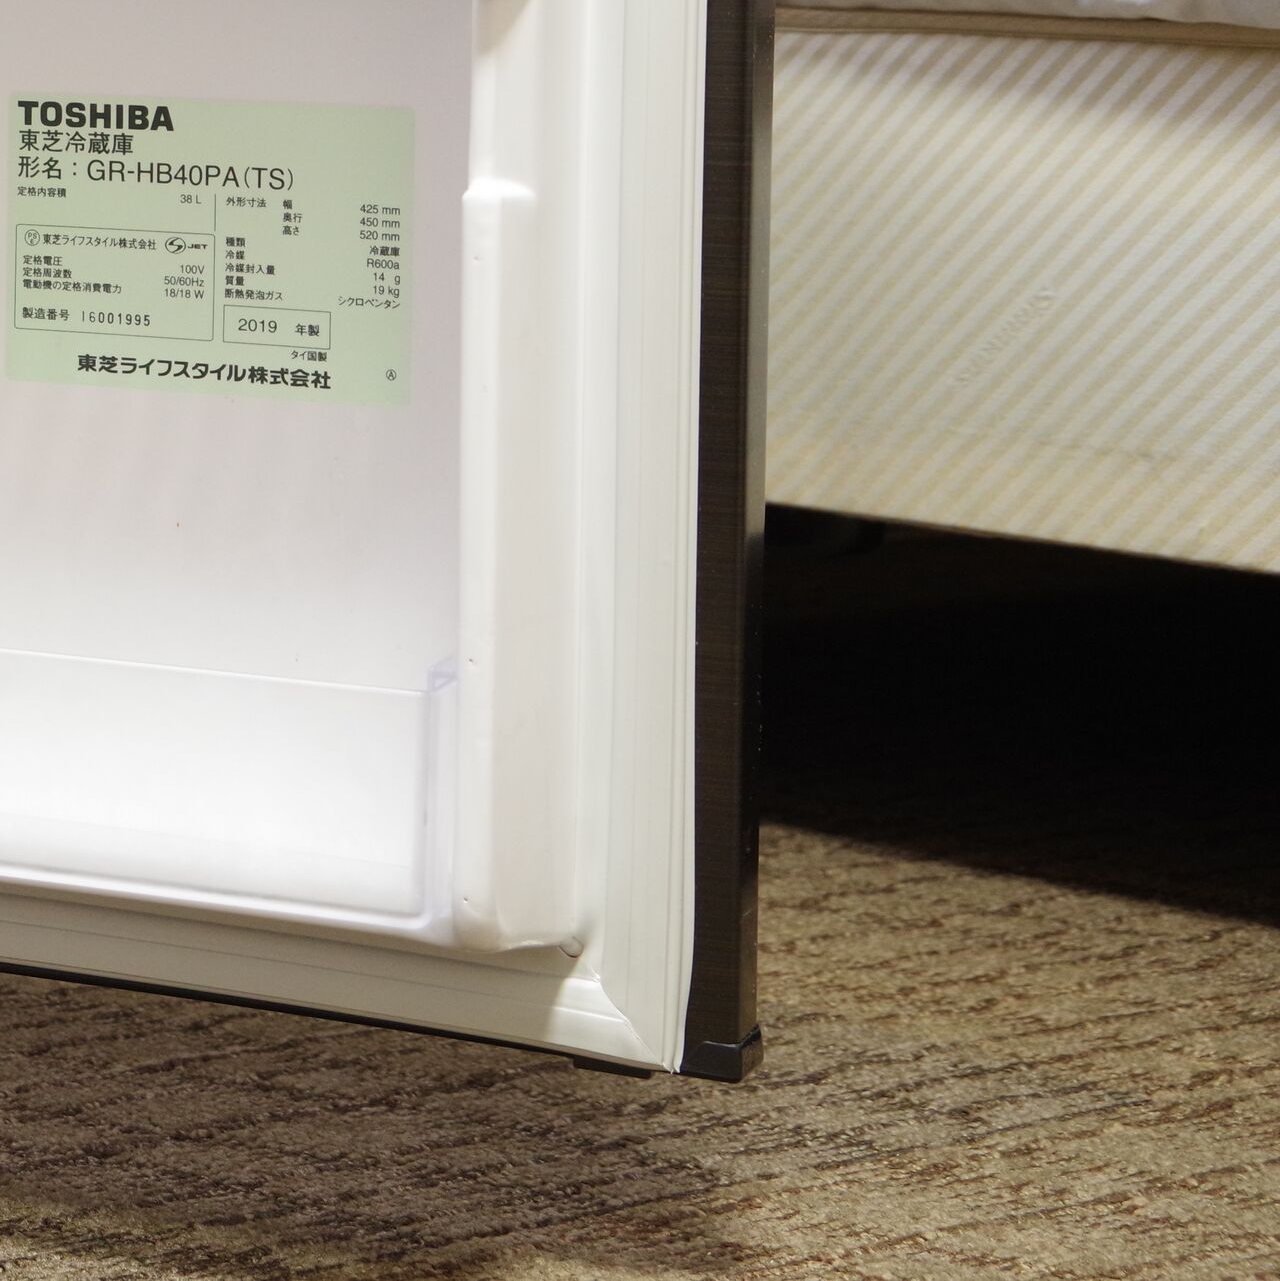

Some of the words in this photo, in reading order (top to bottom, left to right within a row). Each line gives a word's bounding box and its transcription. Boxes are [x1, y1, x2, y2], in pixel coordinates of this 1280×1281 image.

[18, 100, 174, 131] TOSHIBA
[19, 129, 134, 155] 東芝冷蔵庫
[17, 186, 66, 198] 定格内容積
[226, 197, 266, 208] 外形寸法
[282, 199, 293, 210] 幅
[360, 204, 379, 214] 425
[382, 207, 401, 216] mm
[282, 212, 303, 223] 奥行
[360, 217, 378, 227] 450
[381, 220, 400, 229] mm
[42, 233, 157, 251] 東芝ライフスタイル株式会社
[282, 226, 300, 236] 高さ
[359, 230, 378, 240] 520
[381, 233, 400, 242] mm
[226, 237, 245, 247] 種類
[370, 246, 400, 257] 冷蔵庫
[23, 254, 63, 266] 定格電圧
[180, 265, 204, 275] 100V
[225, 250, 245, 260] 冷媒
[367, 258, 400, 270] R600a
[225, 263, 276, 275] 冷媒封入量
[23, 267, 72, 279] 定格周波数
[164, 276, 204, 287] 50/60Hz
[225, 275, 245, 286] 質量
[23, 279, 122, 294] 電動機の定格消費電力
[165, 288, 191, 299] 18/18
[225, 288, 283, 301] 断熱発泡ガス
[338, 296, 400, 309] シクロペンタン
[22, 307, 70, 321] 製造番号
[238, 318, 278, 333] 2019
[294, 324, 320, 337] 年製
[291, 350, 327, 362] タイ国製
[78, 354, 331, 389] 東芝ライフスタイル株式会社
